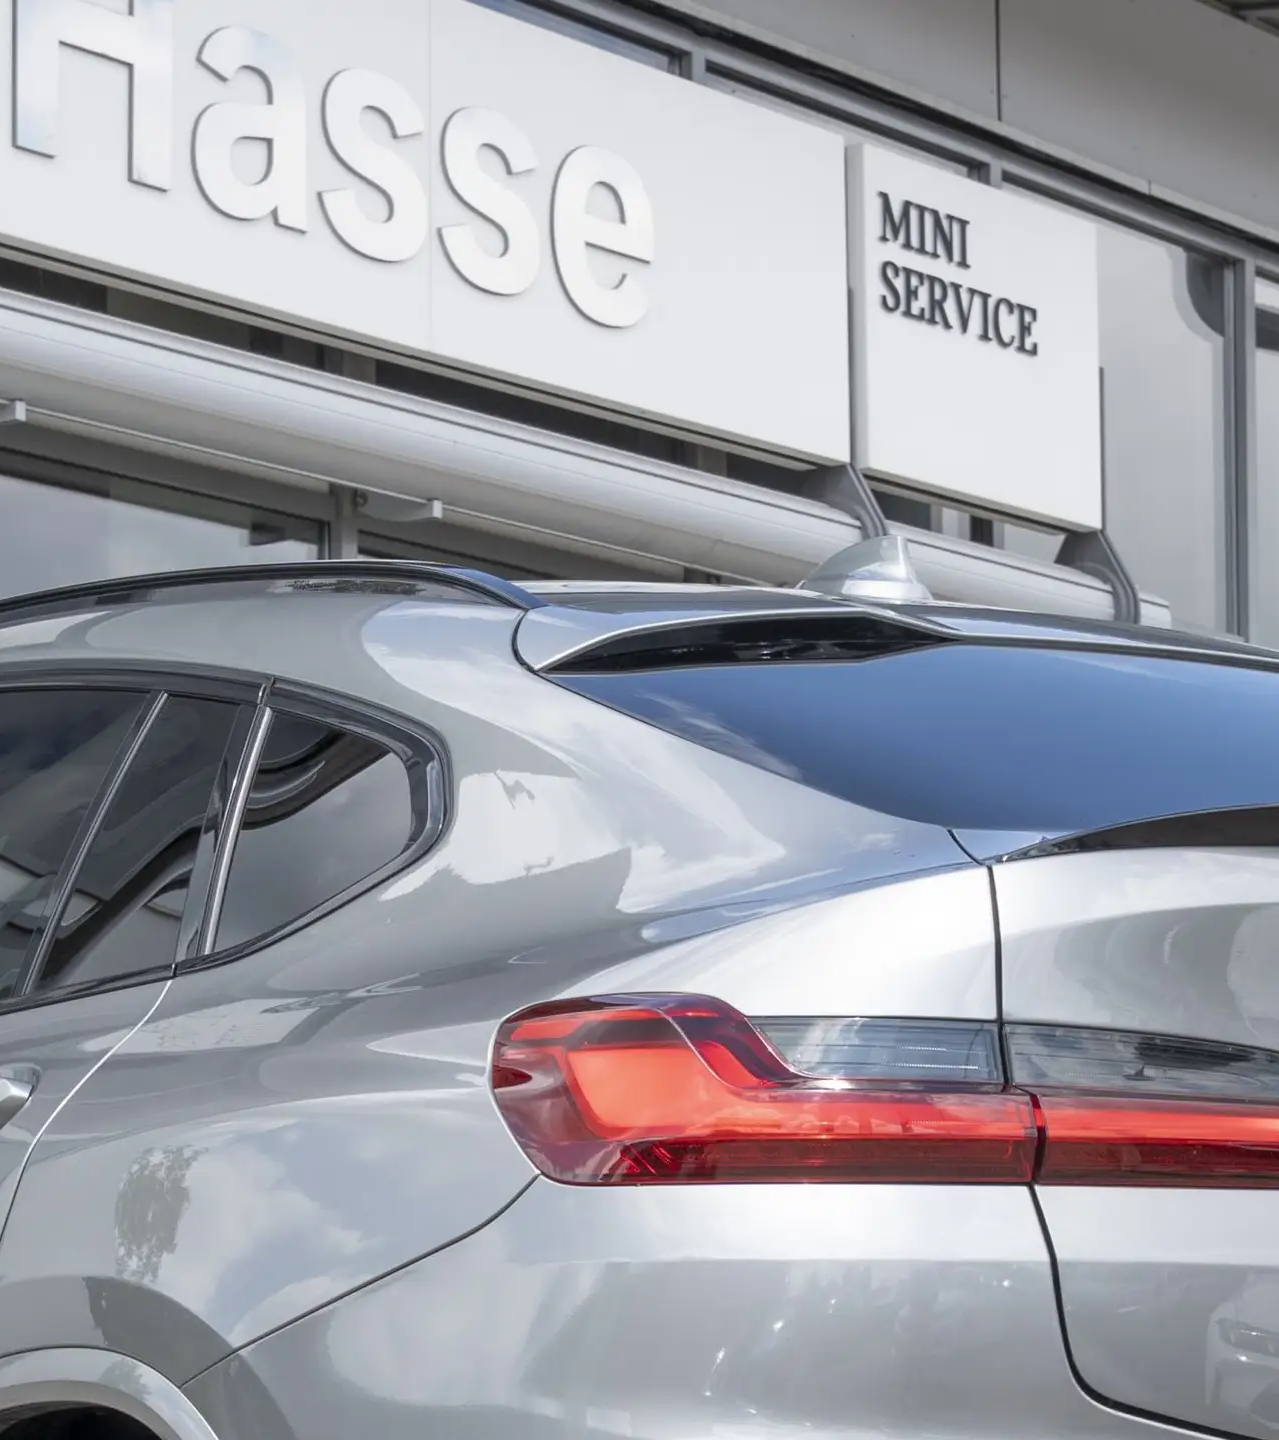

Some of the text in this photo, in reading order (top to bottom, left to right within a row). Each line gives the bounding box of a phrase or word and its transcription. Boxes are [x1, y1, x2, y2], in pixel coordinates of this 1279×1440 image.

[11, 0, 653, 328] Hasse
[877, 191, 971, 269] MINI
[880, 260, 1038, 356] SERVICE
